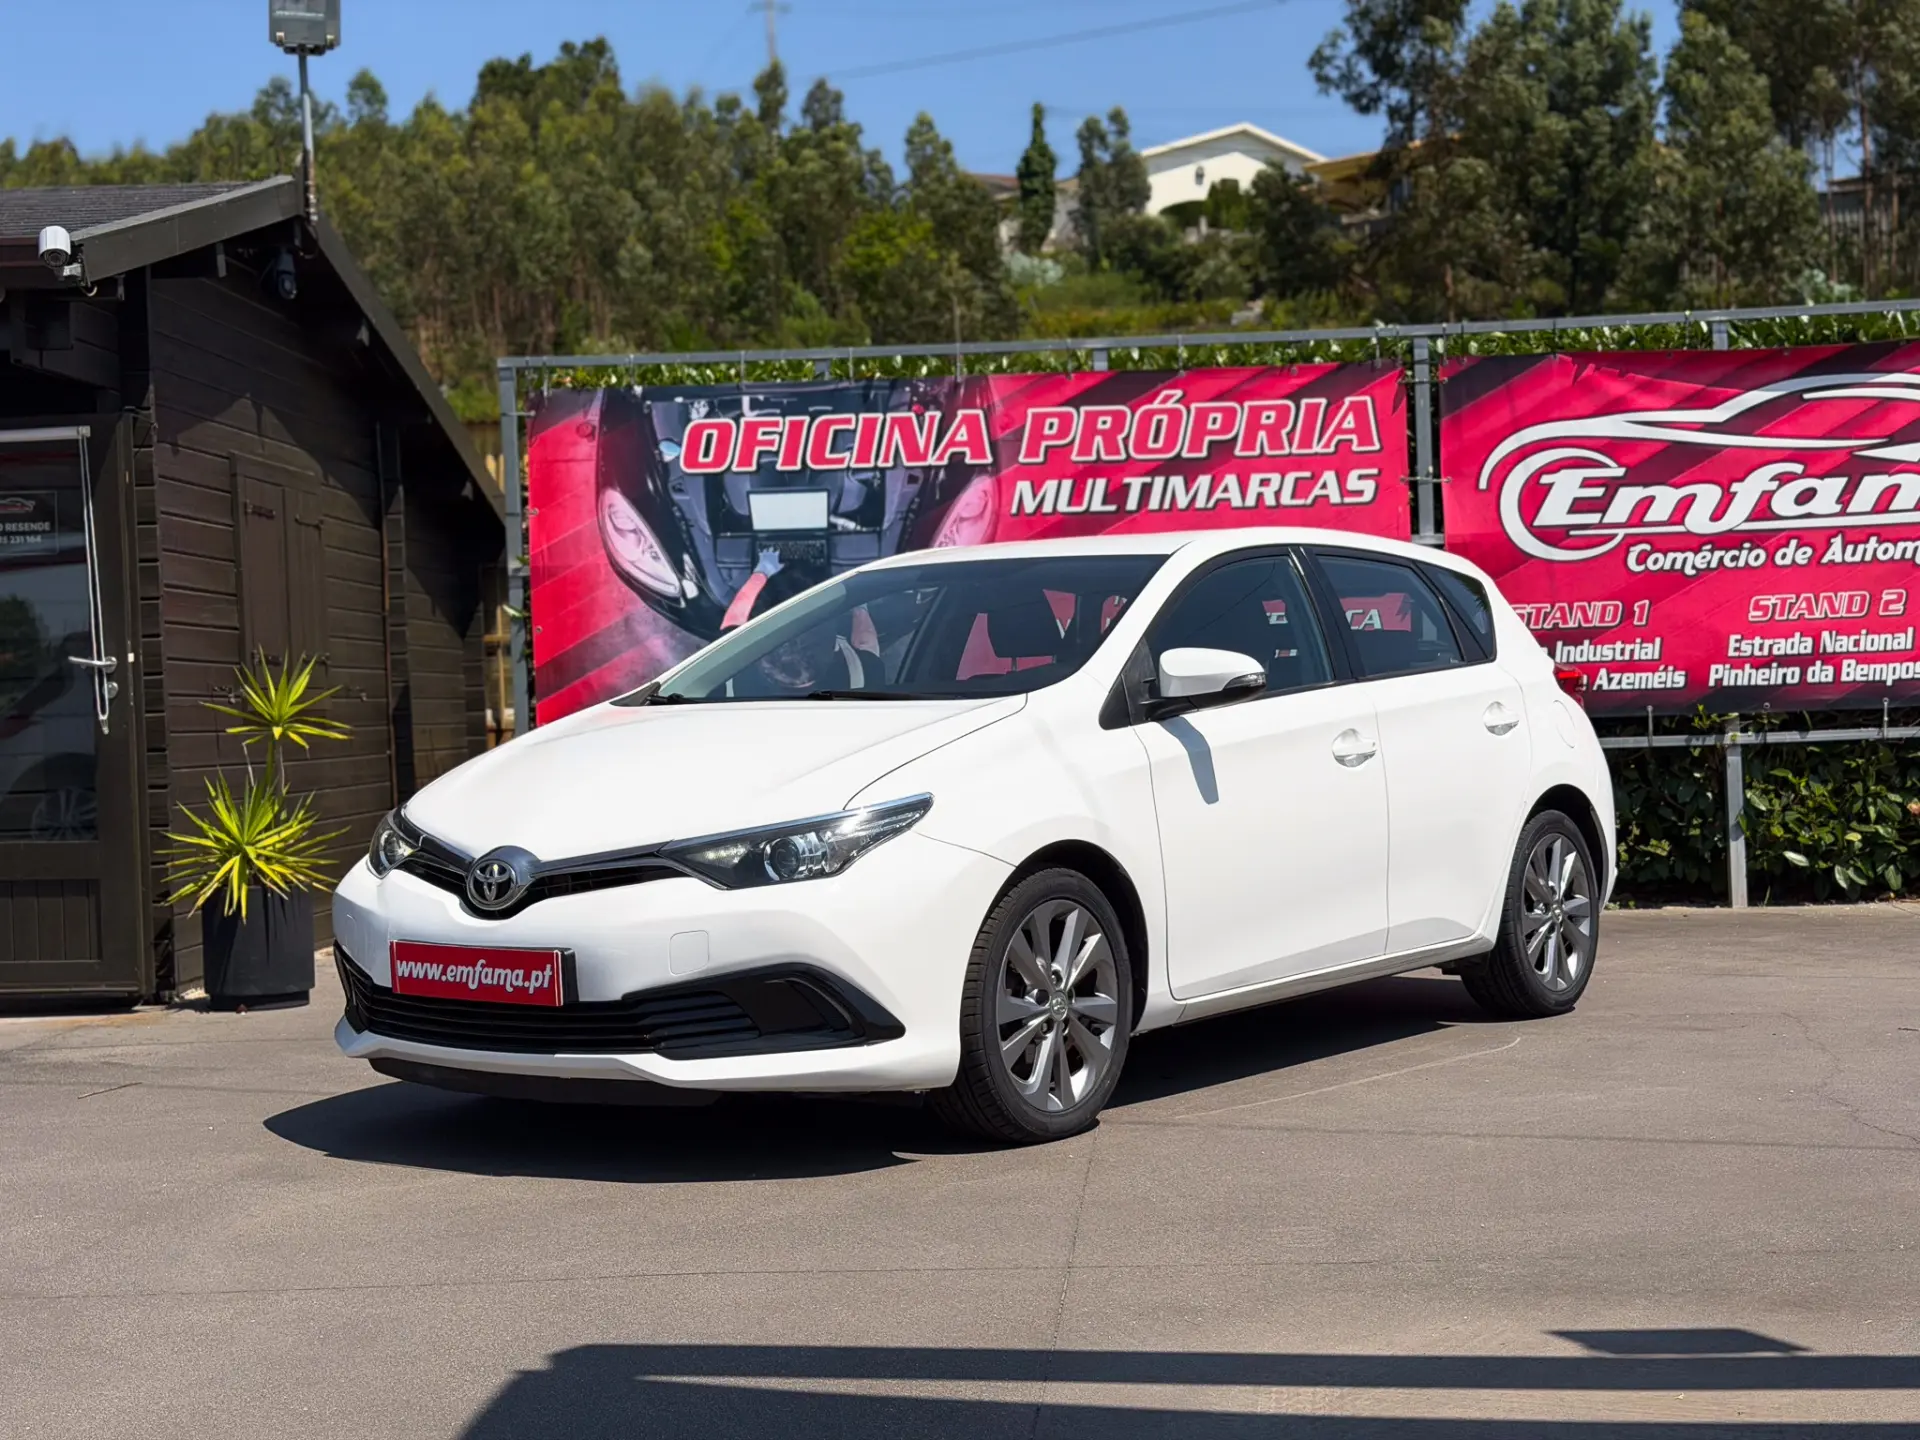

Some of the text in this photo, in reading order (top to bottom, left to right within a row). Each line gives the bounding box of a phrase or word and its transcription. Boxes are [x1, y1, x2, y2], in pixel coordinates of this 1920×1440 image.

[679, 389, 1382, 474] OFICINA PRÓPRIA
[1010, 467, 1380, 516] MULTIMARCAS
[1628, 541, 1767, 576] Comércio
[1774, 538, 1813, 566] de
[1633, 599, 1650, 626] 1
[1748, 588, 1906, 621] STAND 2
[1555, 637, 1662, 663] Industrial
[1727, 626, 1915, 657] Estrada Nacional
[1592, 664, 1686, 691] Azeméis
[1708, 662, 1801, 687] Pinheiro
[1807, 660, 1834, 684] da
[396, 958, 552, 995] www.emfama.pt
